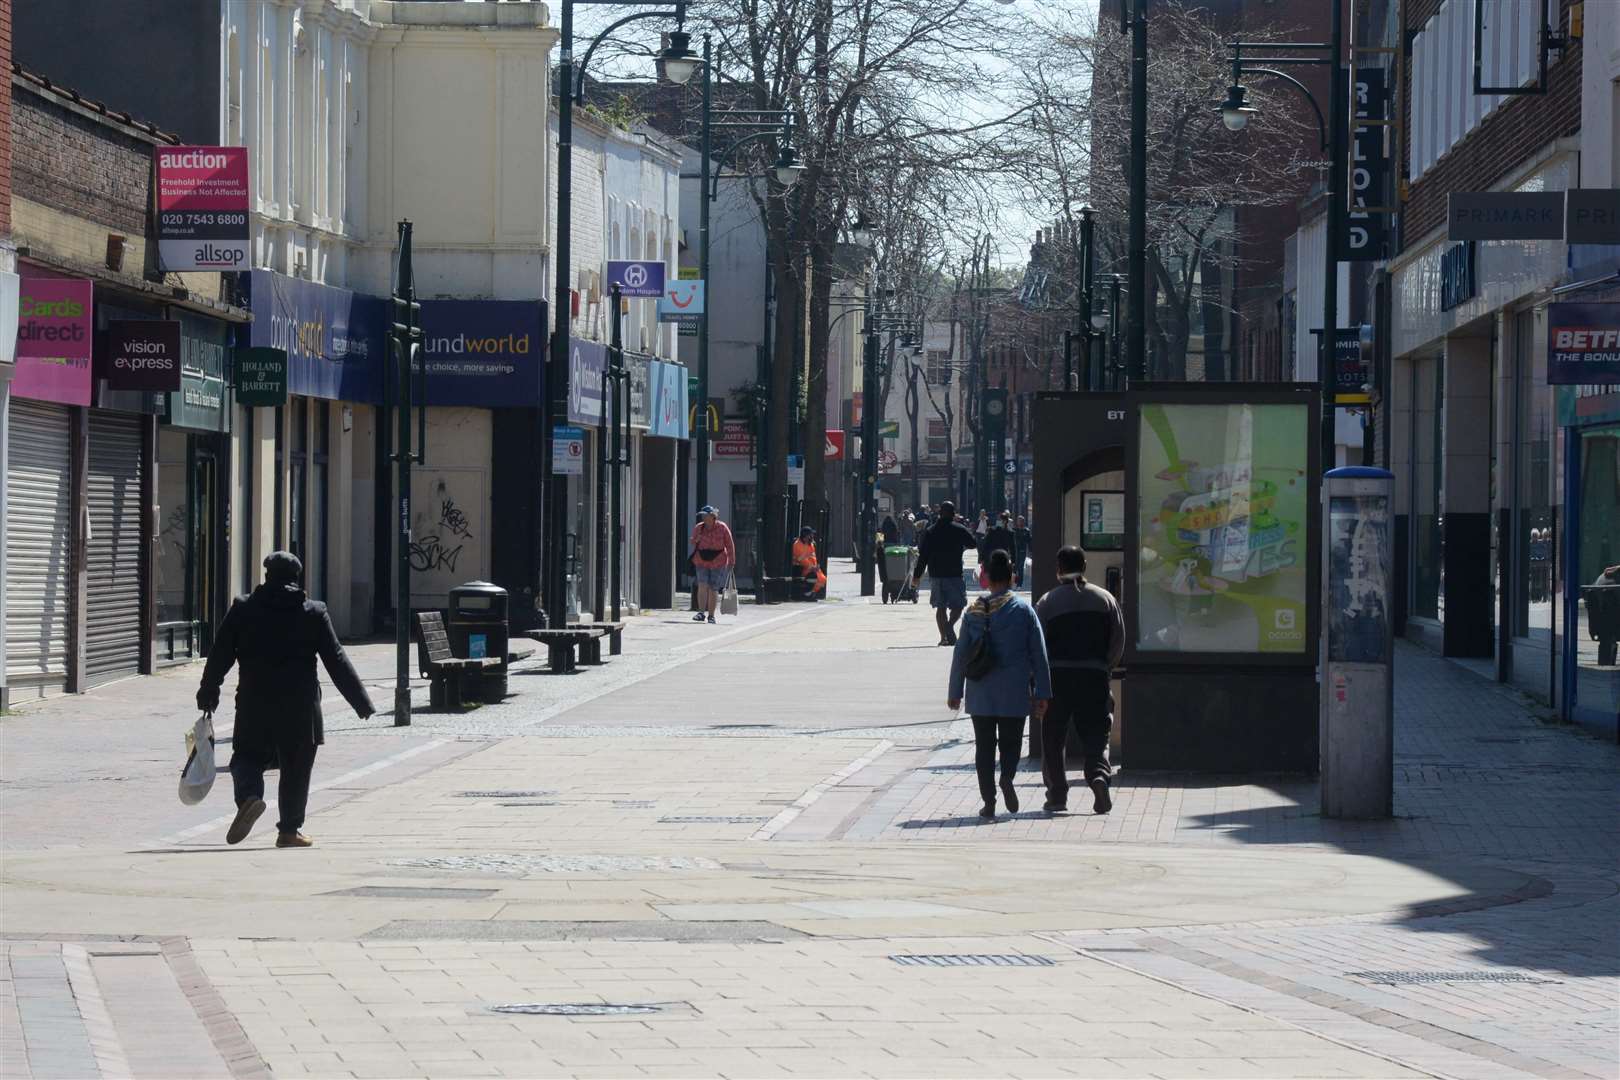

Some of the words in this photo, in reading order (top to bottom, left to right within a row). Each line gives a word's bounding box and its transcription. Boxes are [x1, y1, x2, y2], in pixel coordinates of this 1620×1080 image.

[160, 150, 227, 169] auction
[162, 214, 183, 225] 020
[187, 214, 214, 225] 7543
[217, 214, 245, 225] 6800
[1456, 208, 1553, 223] PRIMARK
[195, 244, 244, 266] allsop
[19, 296, 83, 317] Cards
[18, 321, 85, 342] direct
[123, 339, 166, 354] vision
[424, 333, 529, 353] undworld
[114, 357, 174, 372] express
[1555, 353, 1580, 361] THE
[241, 362, 282, 374] HOLLAND
[463, 364, 484, 372] more
[485, 364, 515, 374] savings
[257, 372, 266, 382] &
[241, 382, 281, 393] BARRETT
[1107, 410, 1127, 420] BT
